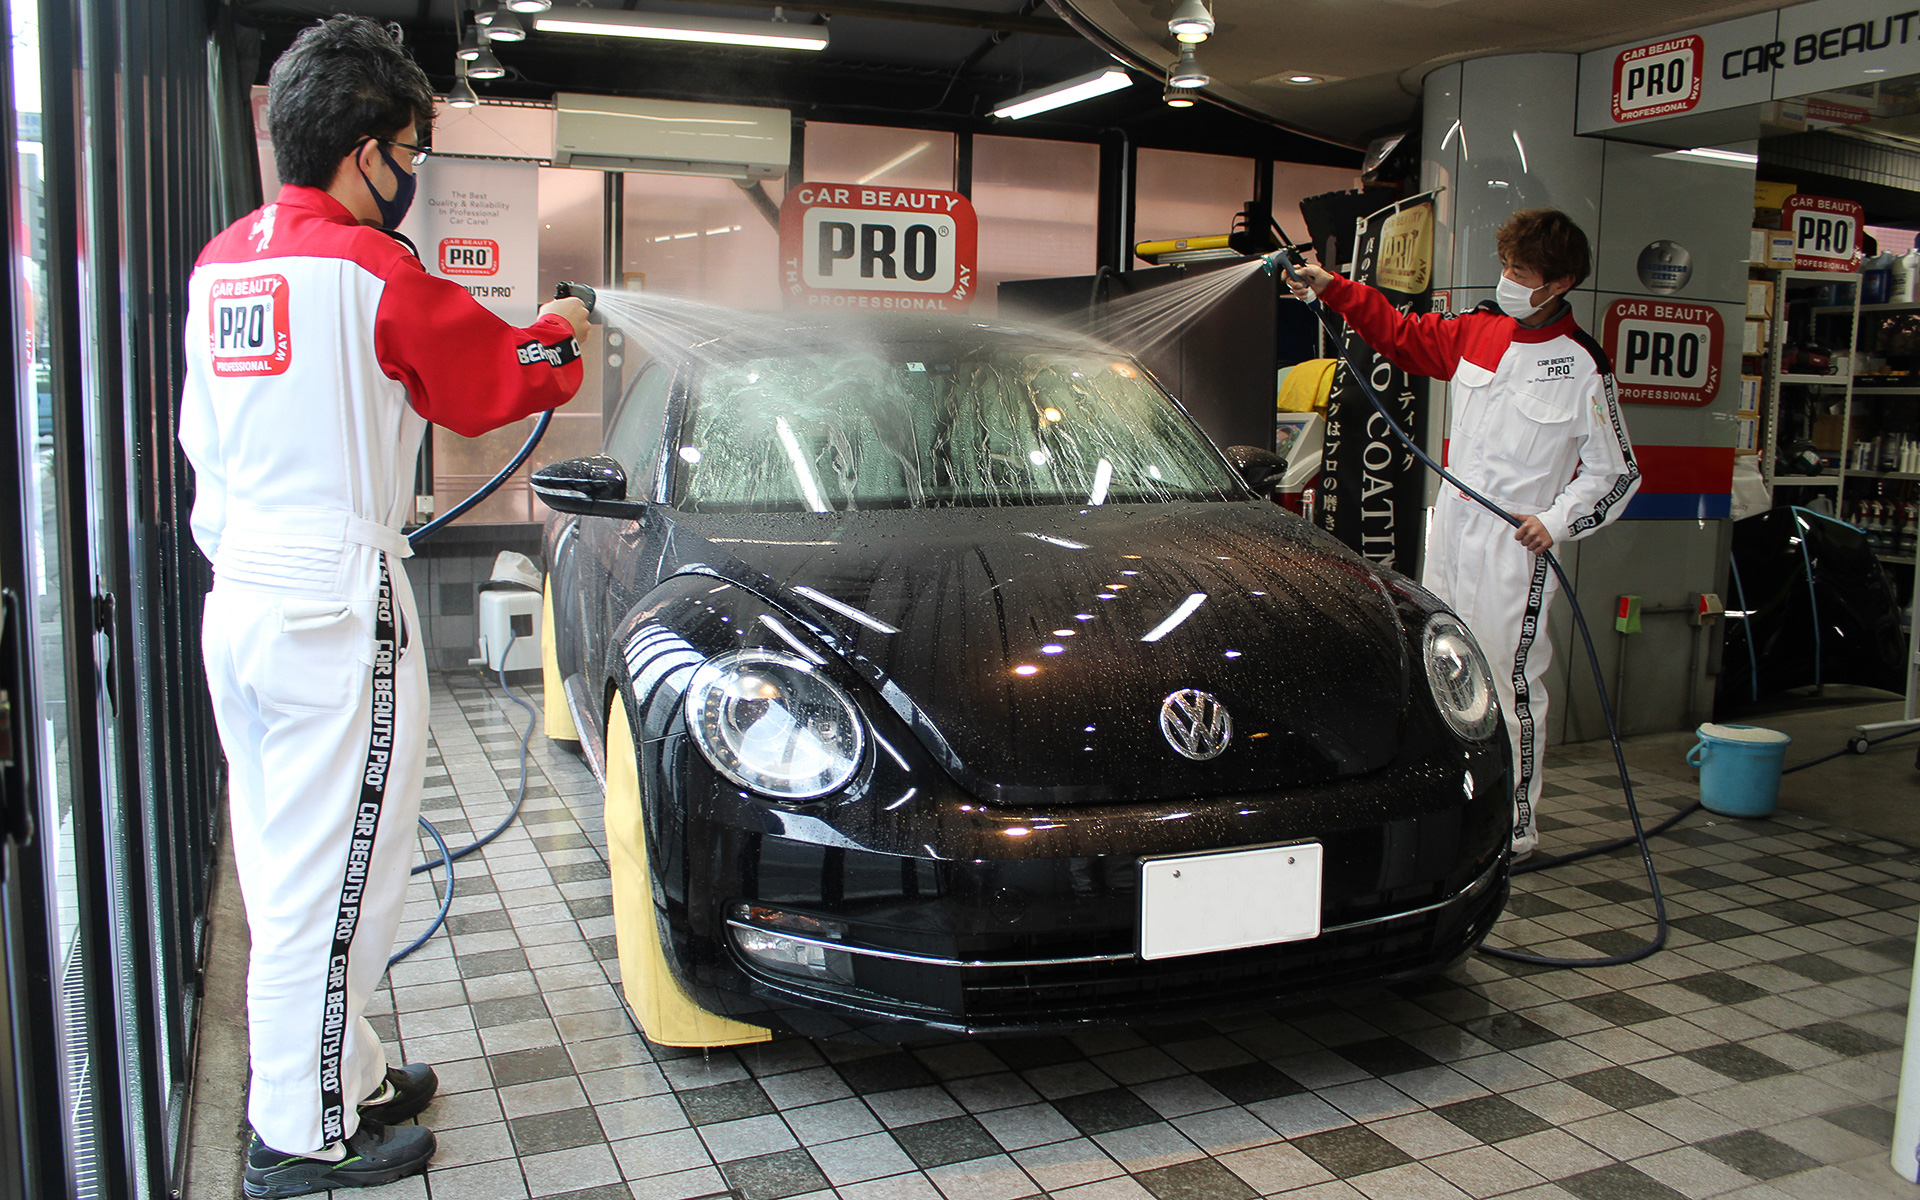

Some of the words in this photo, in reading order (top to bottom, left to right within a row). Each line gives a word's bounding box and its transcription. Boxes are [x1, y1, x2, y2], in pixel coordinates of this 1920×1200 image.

[1622, 46, 1647, 62] CAR
[1648, 37, 1694, 56] BEAUTY
[1722, 41, 1785, 80] CAR
[1793, 10, 1920, 66] BEAUT
[1690, 76, 1700, 100] WAY
[1621, 102, 1688, 120] PROFESSIONAL
[428, 198, 458, 208] Quality
[470, 201, 510, 211] Reliability
[451, 191, 466, 199] The
[469, 192, 487, 200] Best
[799, 188, 849, 204] CAR
[861, 190, 959, 212] BEAUTY
[1790, 197, 1814, 207] CAR
[1817, 199, 1858, 214] BEAUTY
[449, 209, 499, 217] Professional
[449, 217, 464, 225] Car
[786, 258, 803, 296] THE
[952, 264, 971, 301] WAY
[1416, 259, 1427, 284] WAY
[212, 282, 233, 298] CAR
[234, 278, 282, 296] BEAUTY
[808, 295, 947, 311] PROFESSIONAL
[1432, 299, 1445, 312] RO
[1617, 304, 1648, 317] CAR
[1654, 305, 1714, 323] BEAUTY
[275, 332, 287, 361] WAY
[216, 360, 272, 372] PROFESSIONAL
[1537, 359, 1550, 367] CAR
[1705, 365, 1718, 394] WAY
[1618, 388, 1702, 402] PROFESSIONAL
[1605, 475, 1630, 505] EAUTY
[1523, 615, 1536, 637] CAR
[374, 639, 394, 675] CAR
[372, 678, 393, 748] BEAUTY
[354, 802, 379, 837] CAR
[342, 838, 372, 904] BEAUTY
[328, 954, 346, 990] CAR
[322, 990, 345, 1058] BEAUTY
[323, 1104, 342, 1141] CAR
